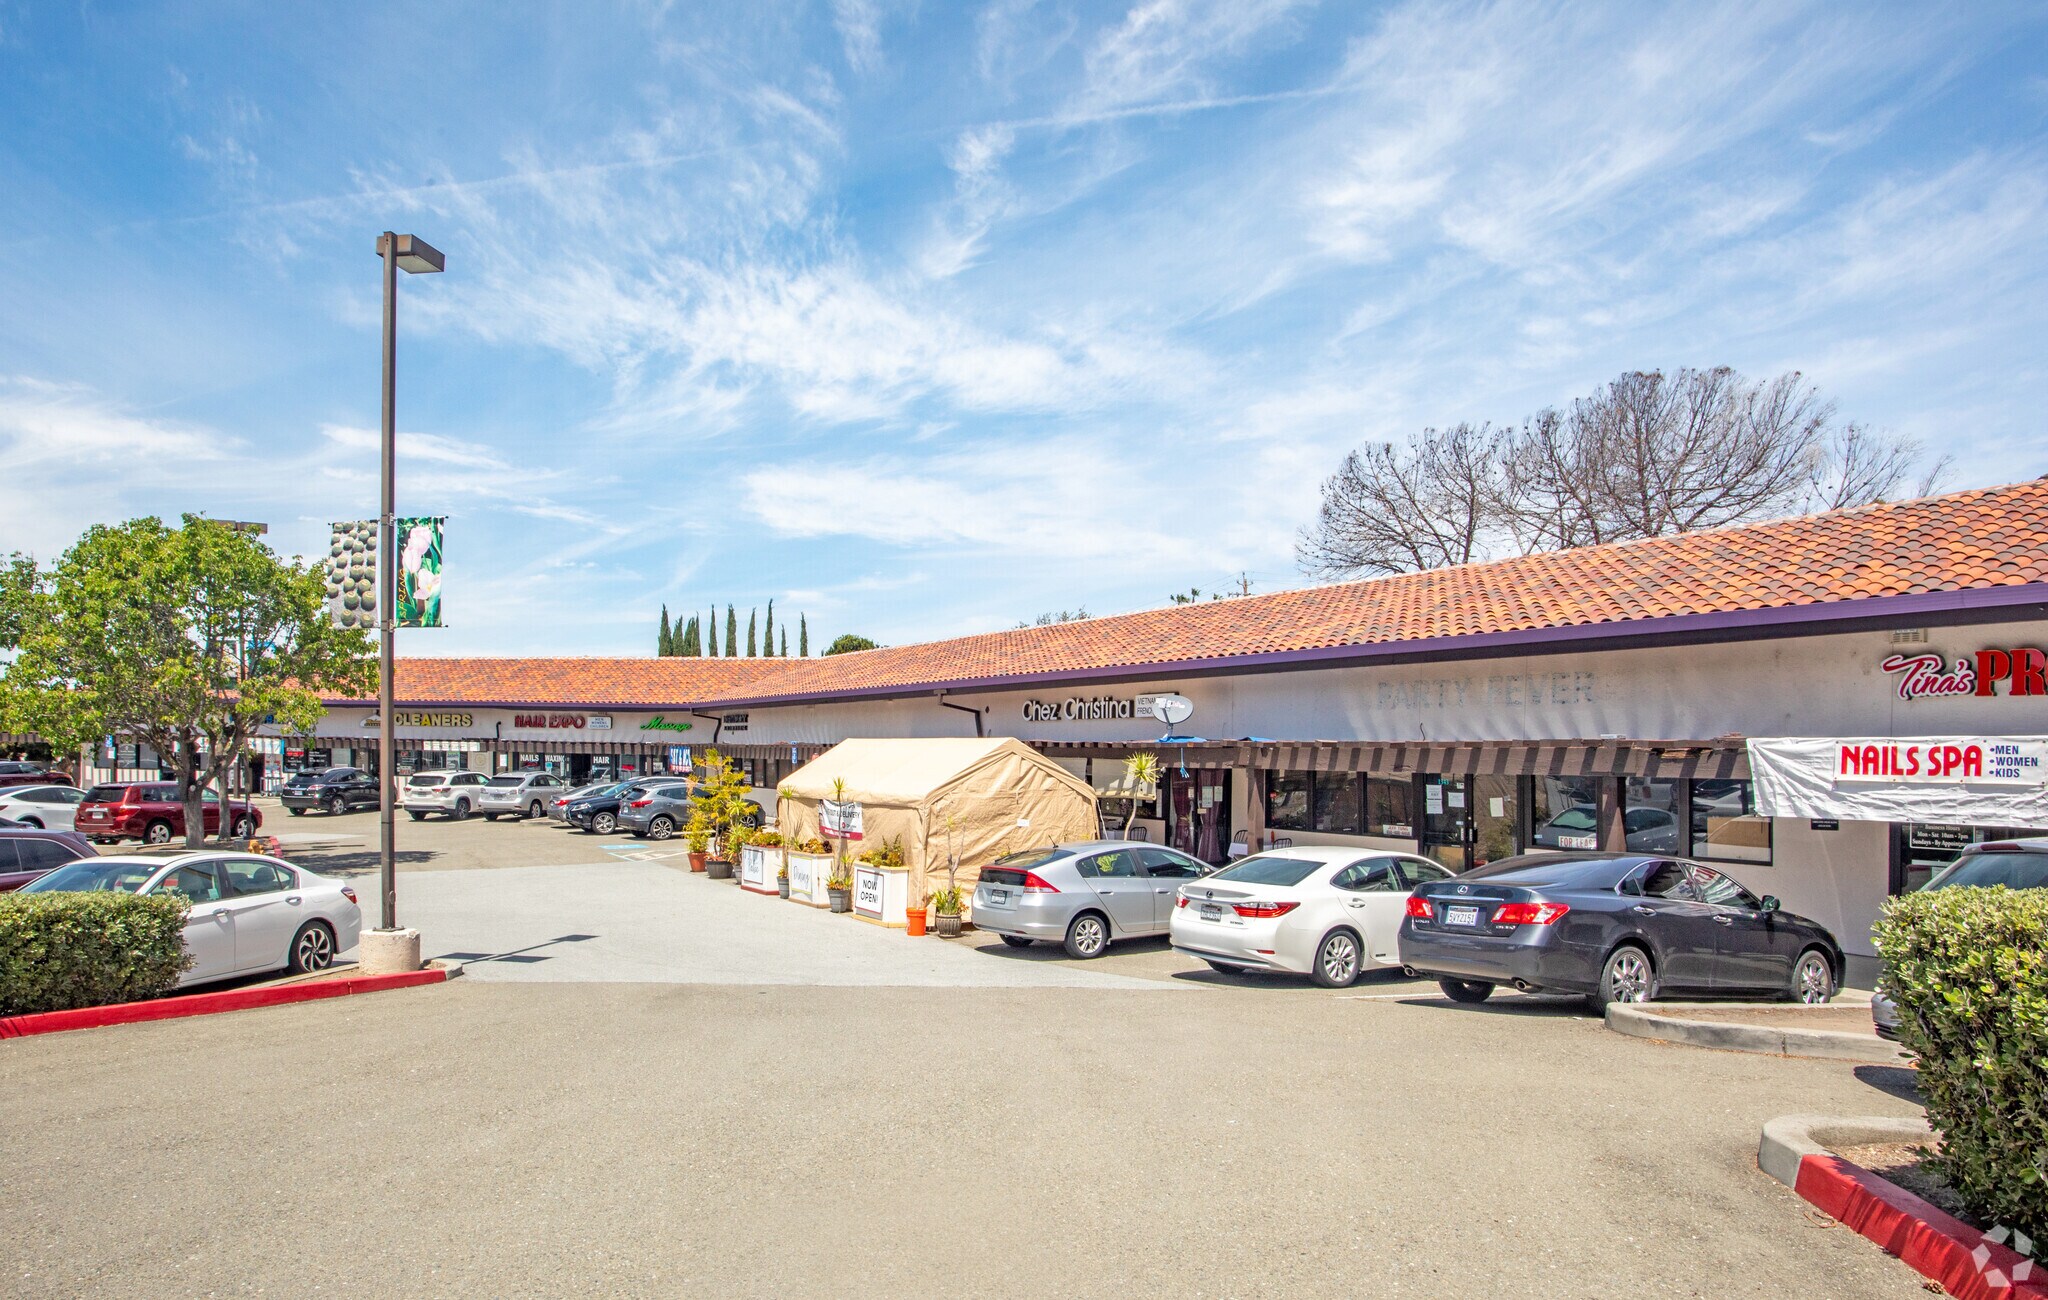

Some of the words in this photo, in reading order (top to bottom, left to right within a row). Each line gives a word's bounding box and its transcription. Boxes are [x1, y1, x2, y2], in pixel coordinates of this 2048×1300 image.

[1881, 654, 1975, 700] Tina's
[1974, 648, 2048, 697] PR
[1377, 677, 1471, 710] PARTY
[1487, 671, 1597, 706] FEVER
[1021, 700, 1059, 721] Chez
[1064, 696, 1131, 720] Christina
[394, 713, 473, 727] CLEANERS
[514, 715, 546, 728] HAIR
[549, 715, 586, 729] EXPO
[640, 716, 692, 732] Massage
[1995, 745, 2019, 755] MEN
[520, 754, 540, 762] NAILS
[593, 756, 610, 764] HAIR
[1841, 745, 1920, 776] NAILS
[1927, 745, 1983, 777] SPA
[1995, 757, 2039, 767] WOMEN
[1995, 768, 2020, 778] KIDS
[1560, 837, 1573, 847] FOR
[1576, 838, 1597, 849] LEAS
[862, 879, 877, 890] NOW
[860, 892, 878, 904] OPEN!
